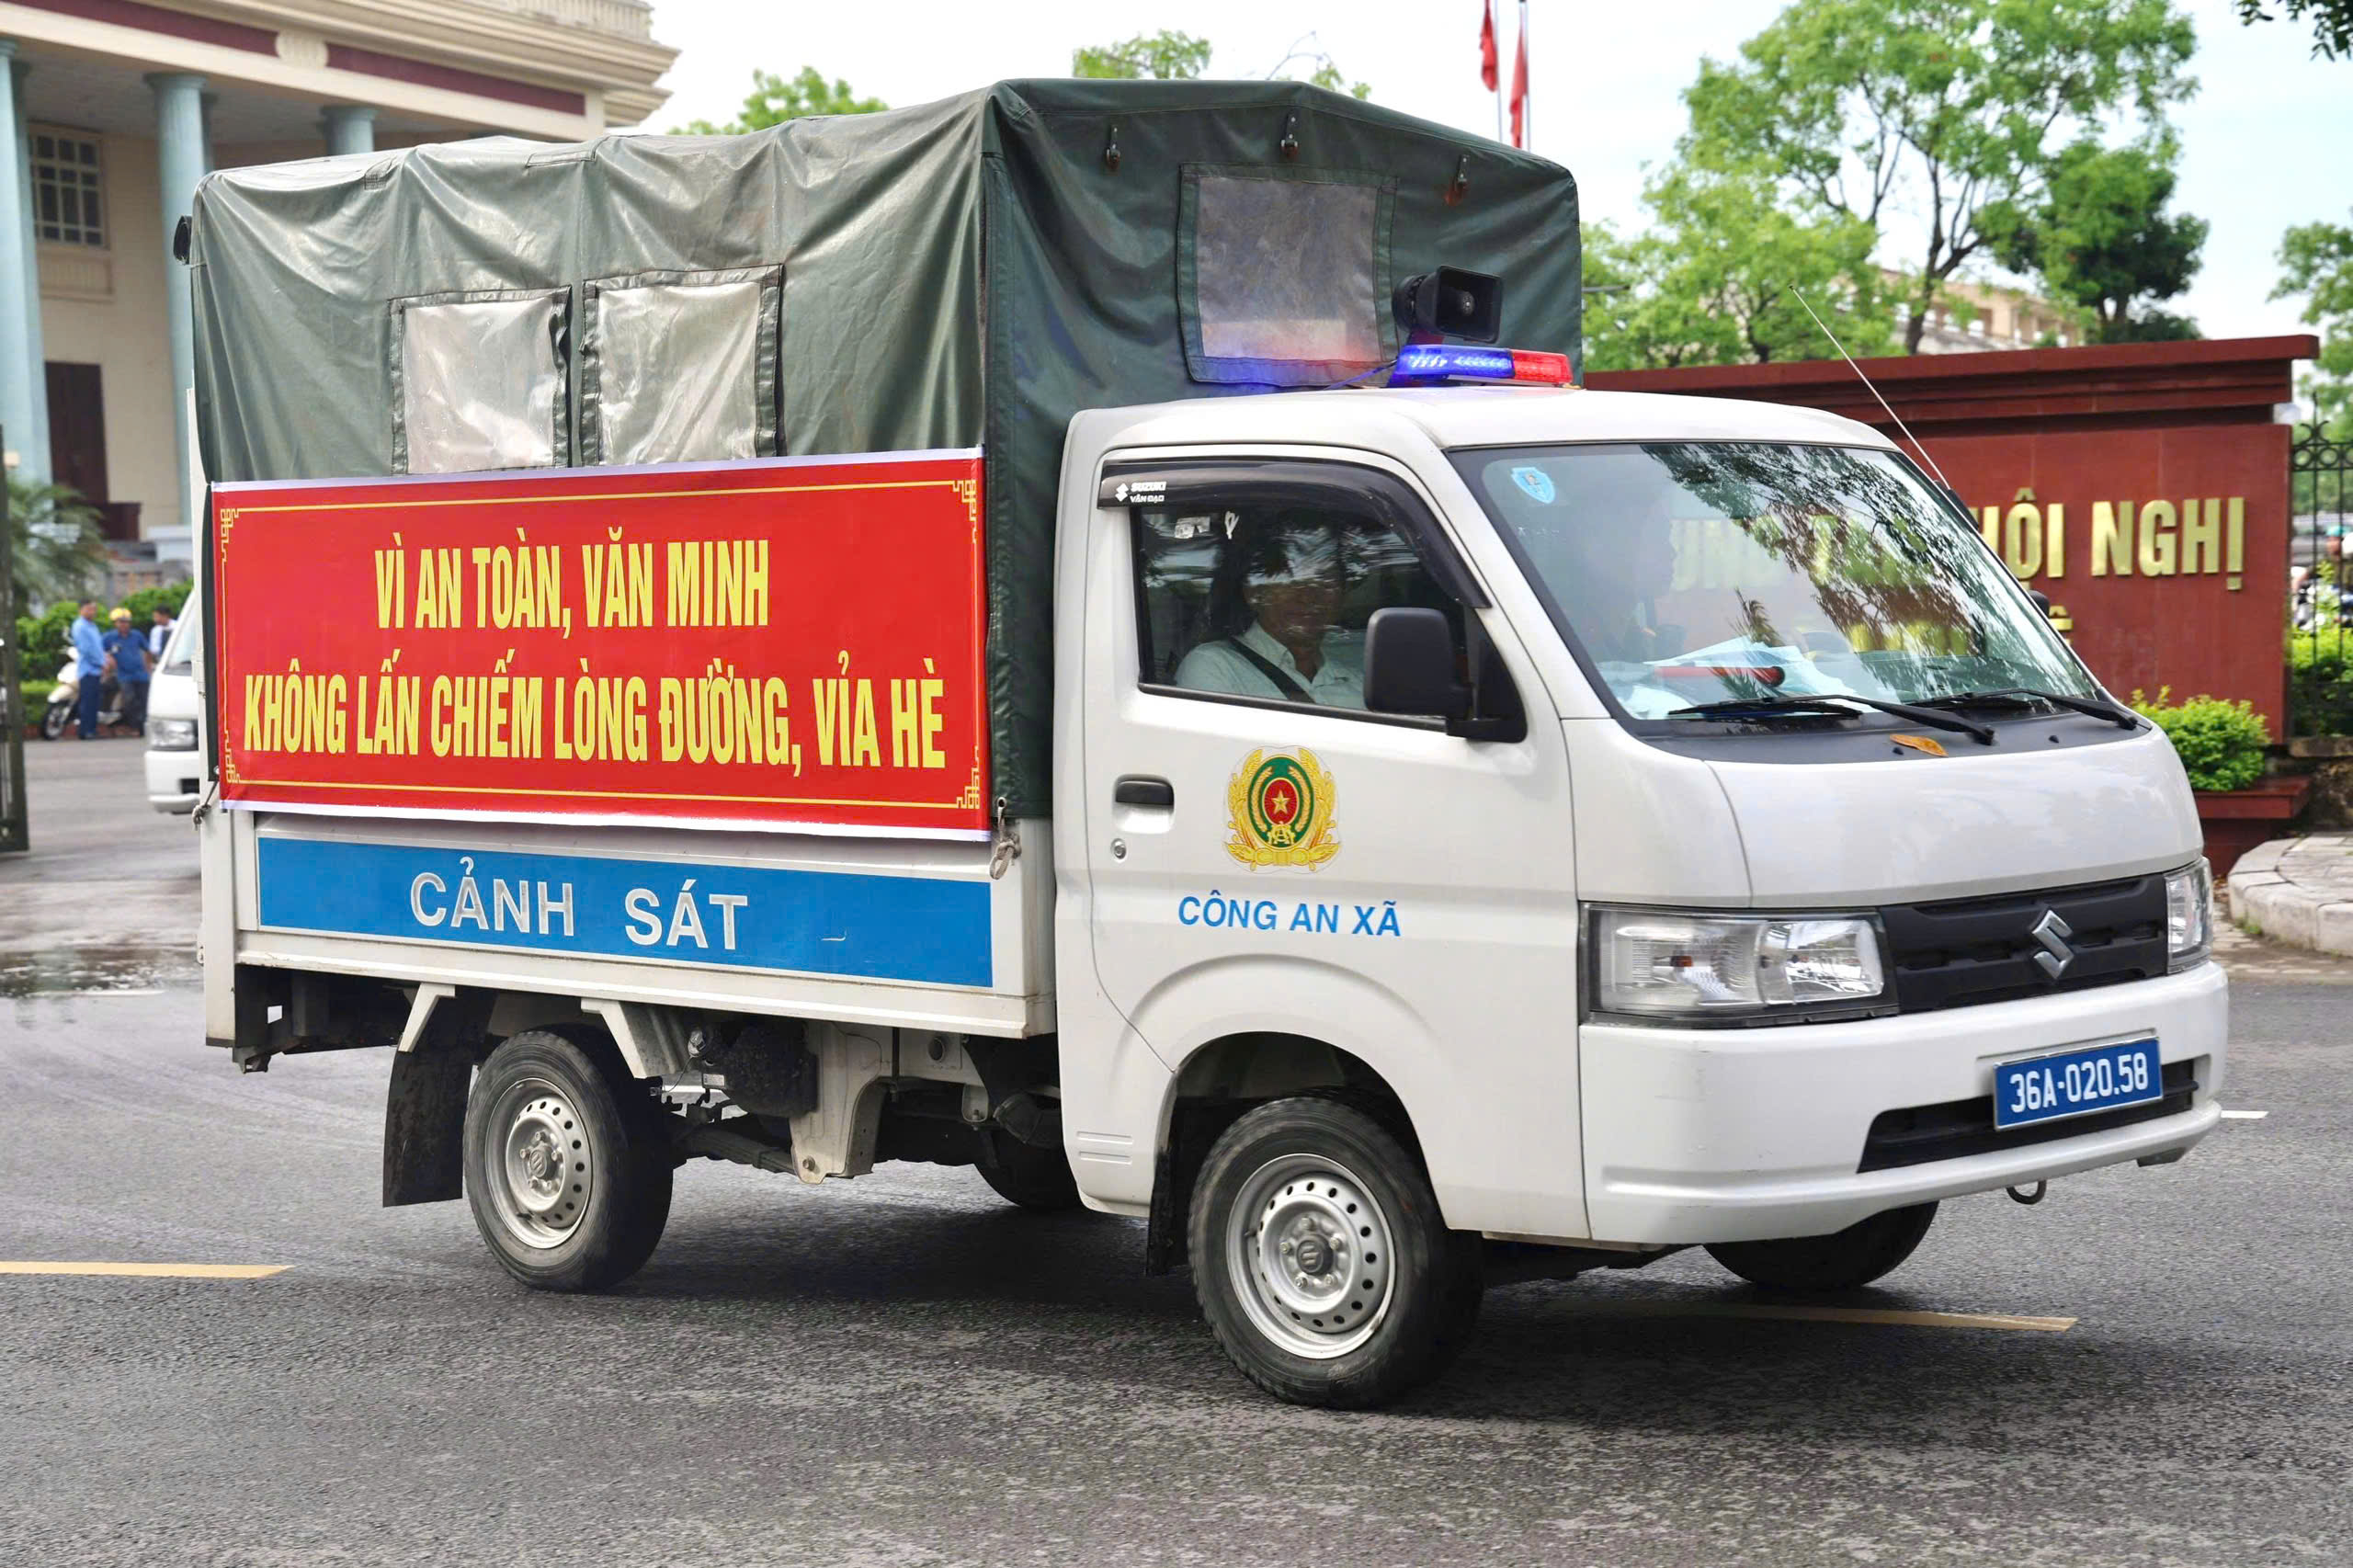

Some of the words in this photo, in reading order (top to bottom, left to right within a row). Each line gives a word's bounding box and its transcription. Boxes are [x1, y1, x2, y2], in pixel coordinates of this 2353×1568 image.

[374, 531, 404, 629] VÌ
[415, 548, 461, 629] AN
[472, 527, 572, 639] TOÀN,
[582, 527, 653, 627] VĂN
[666, 540, 768, 627] MINH
[2091, 497, 2245, 590] NGHỊ
[244, 658, 347, 754] KHÔNG
[357, 648, 421, 756] LẤN
[430, 648, 543, 759] CHIẾM
[554, 657, 648, 762] LÒNG
[659, 657, 801, 777] ĐƯỜNG,
[812, 650, 882, 767] VỈA
[890, 657, 946, 768] HÈ
[410, 856, 574, 936] CẢNH
[624, 879, 747, 949] SÁT
[1178, 890, 1278, 930] CÔNG
[1289, 903, 1339, 933] AN
[1351, 901, 1401, 937] XÃ
